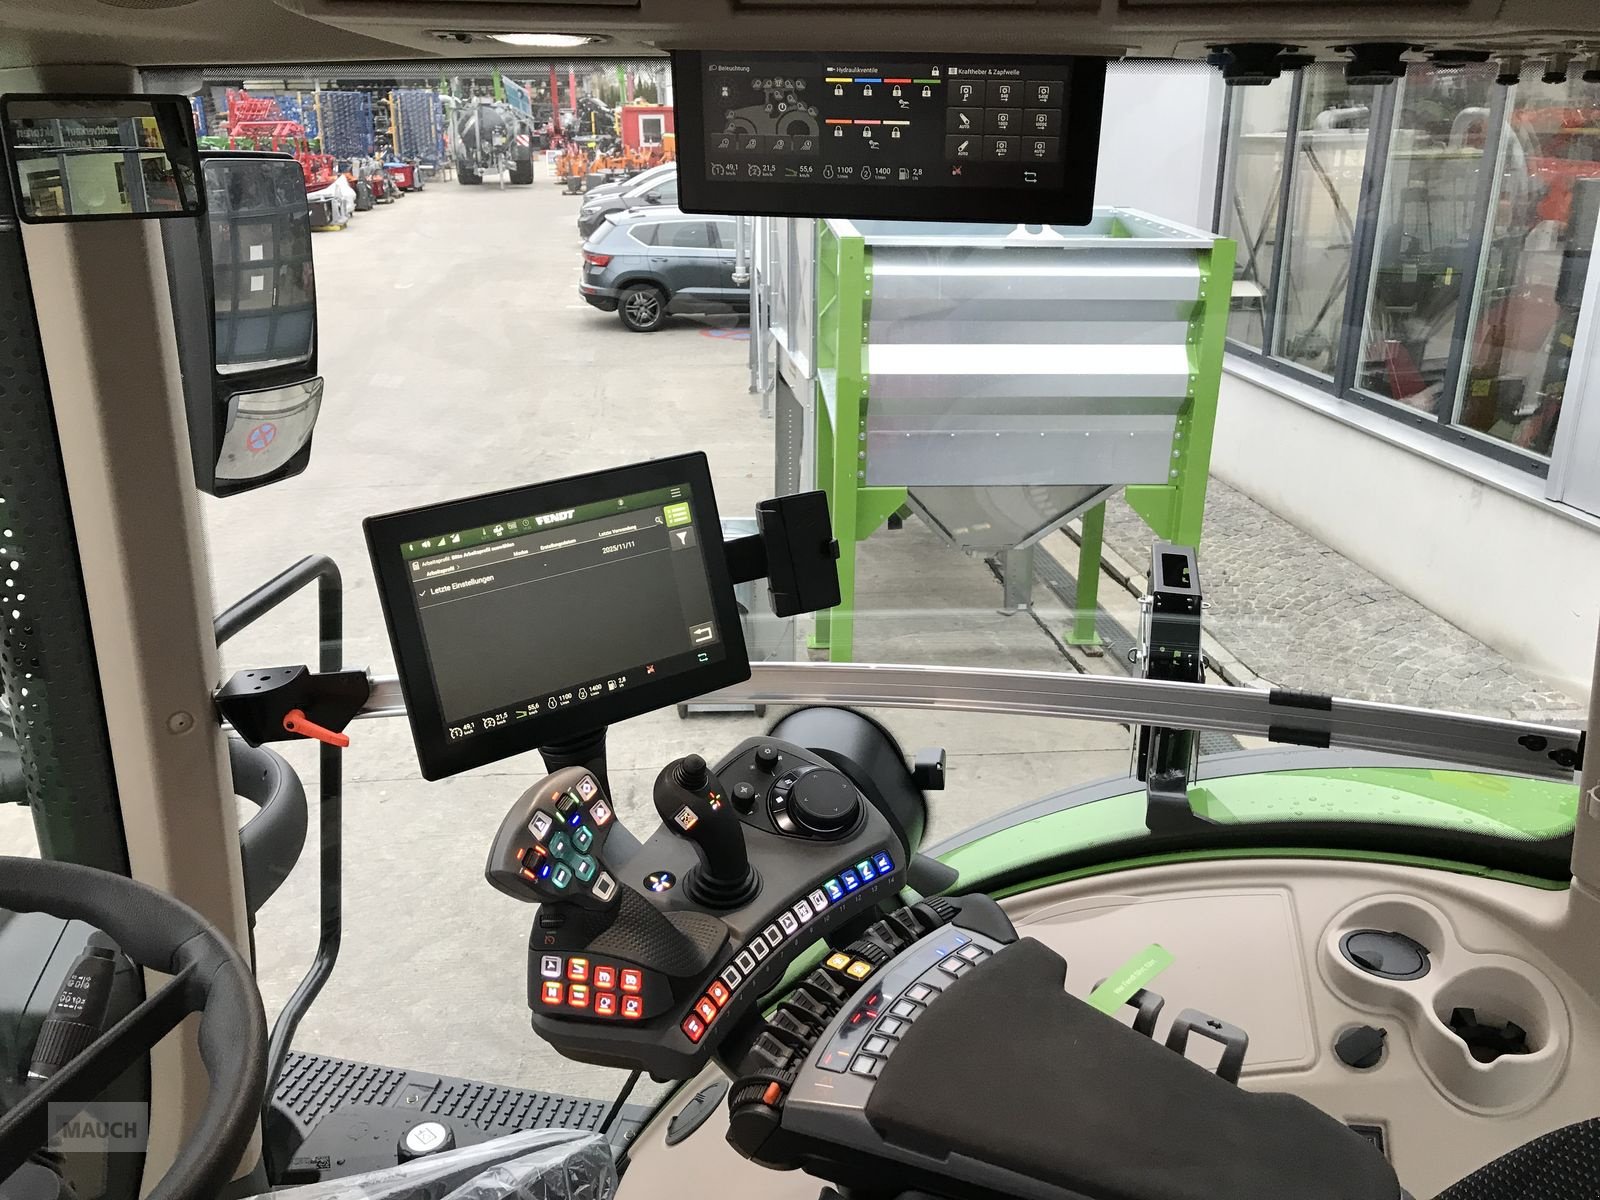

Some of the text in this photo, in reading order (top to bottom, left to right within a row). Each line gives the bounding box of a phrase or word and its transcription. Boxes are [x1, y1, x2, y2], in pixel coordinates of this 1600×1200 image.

[535, 509, 575, 526] FENDT
[602, 541, 635, 554] 2025/11/11
[464, 547, 491, 558] Arbeitsprofil
[427, 566, 455, 576] Arbeitsprofil
[430, 575, 494, 595] Letzte Einstellungen
[588, 684, 602, 692] 1400
[558, 693, 572, 701] 1100
[528, 703, 539, 711] 55,6
[496, 712, 508, 721] 21,5
[463, 722, 475, 731] 49,1
